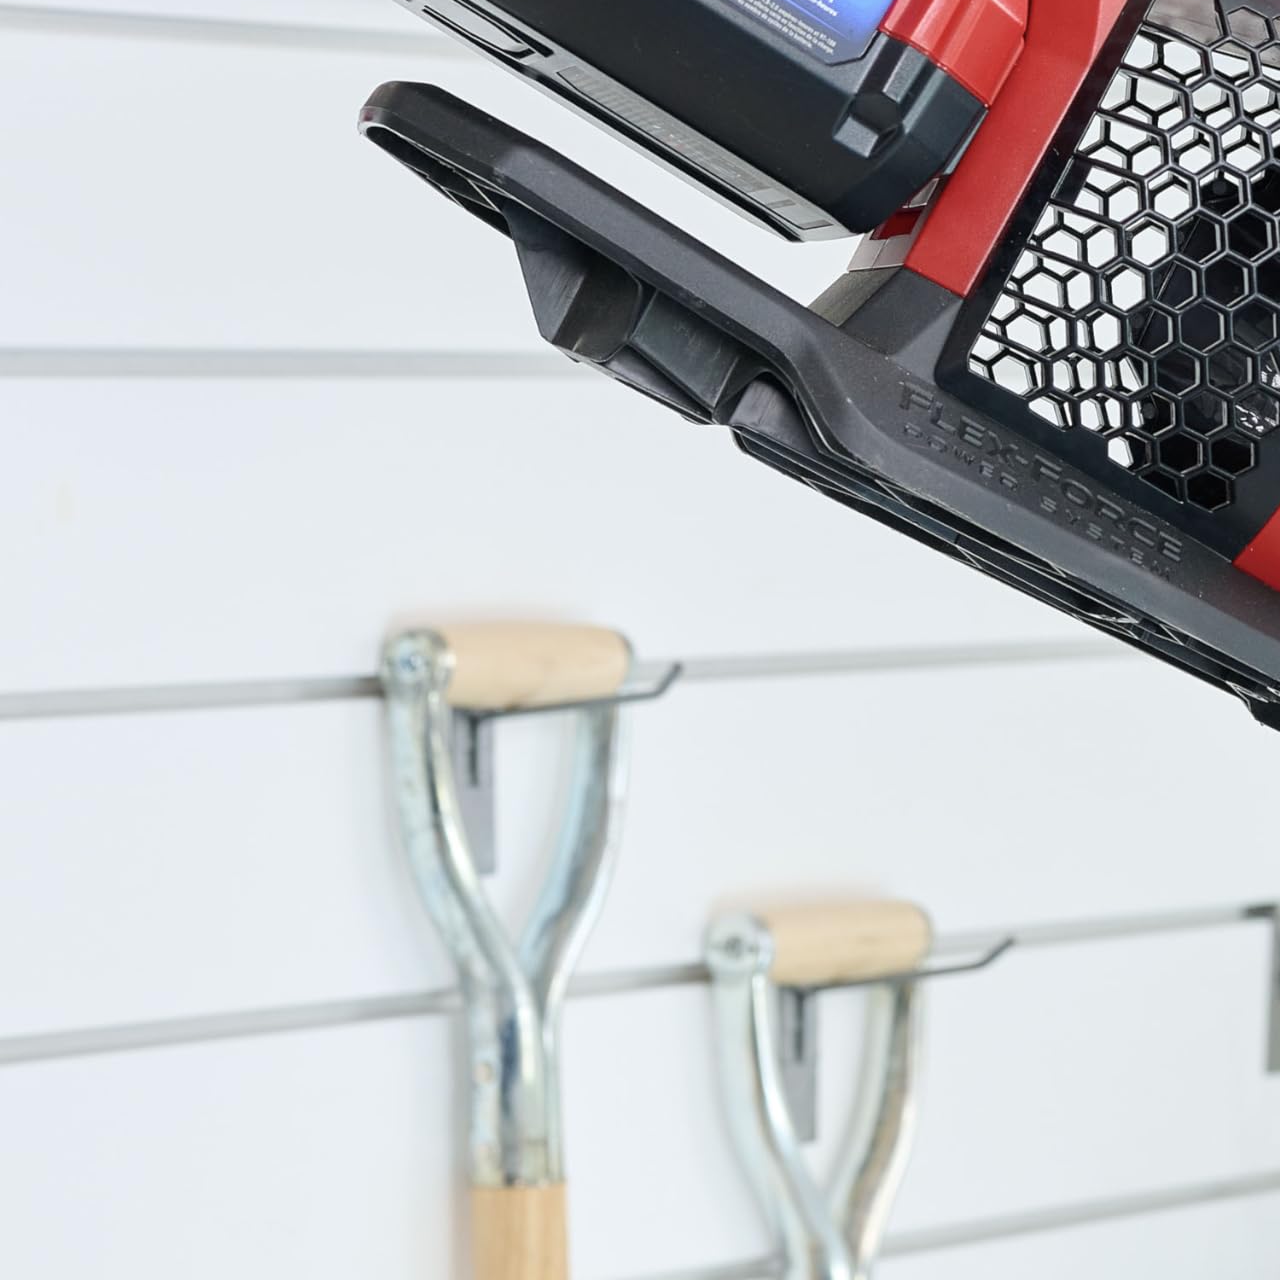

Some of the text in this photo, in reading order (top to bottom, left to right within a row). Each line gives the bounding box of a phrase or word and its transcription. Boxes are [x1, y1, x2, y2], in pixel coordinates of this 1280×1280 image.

[899, 380, 1183, 562] FLEX-FORCE
[902, 420, 1172, 581] POWER SYSTEM
